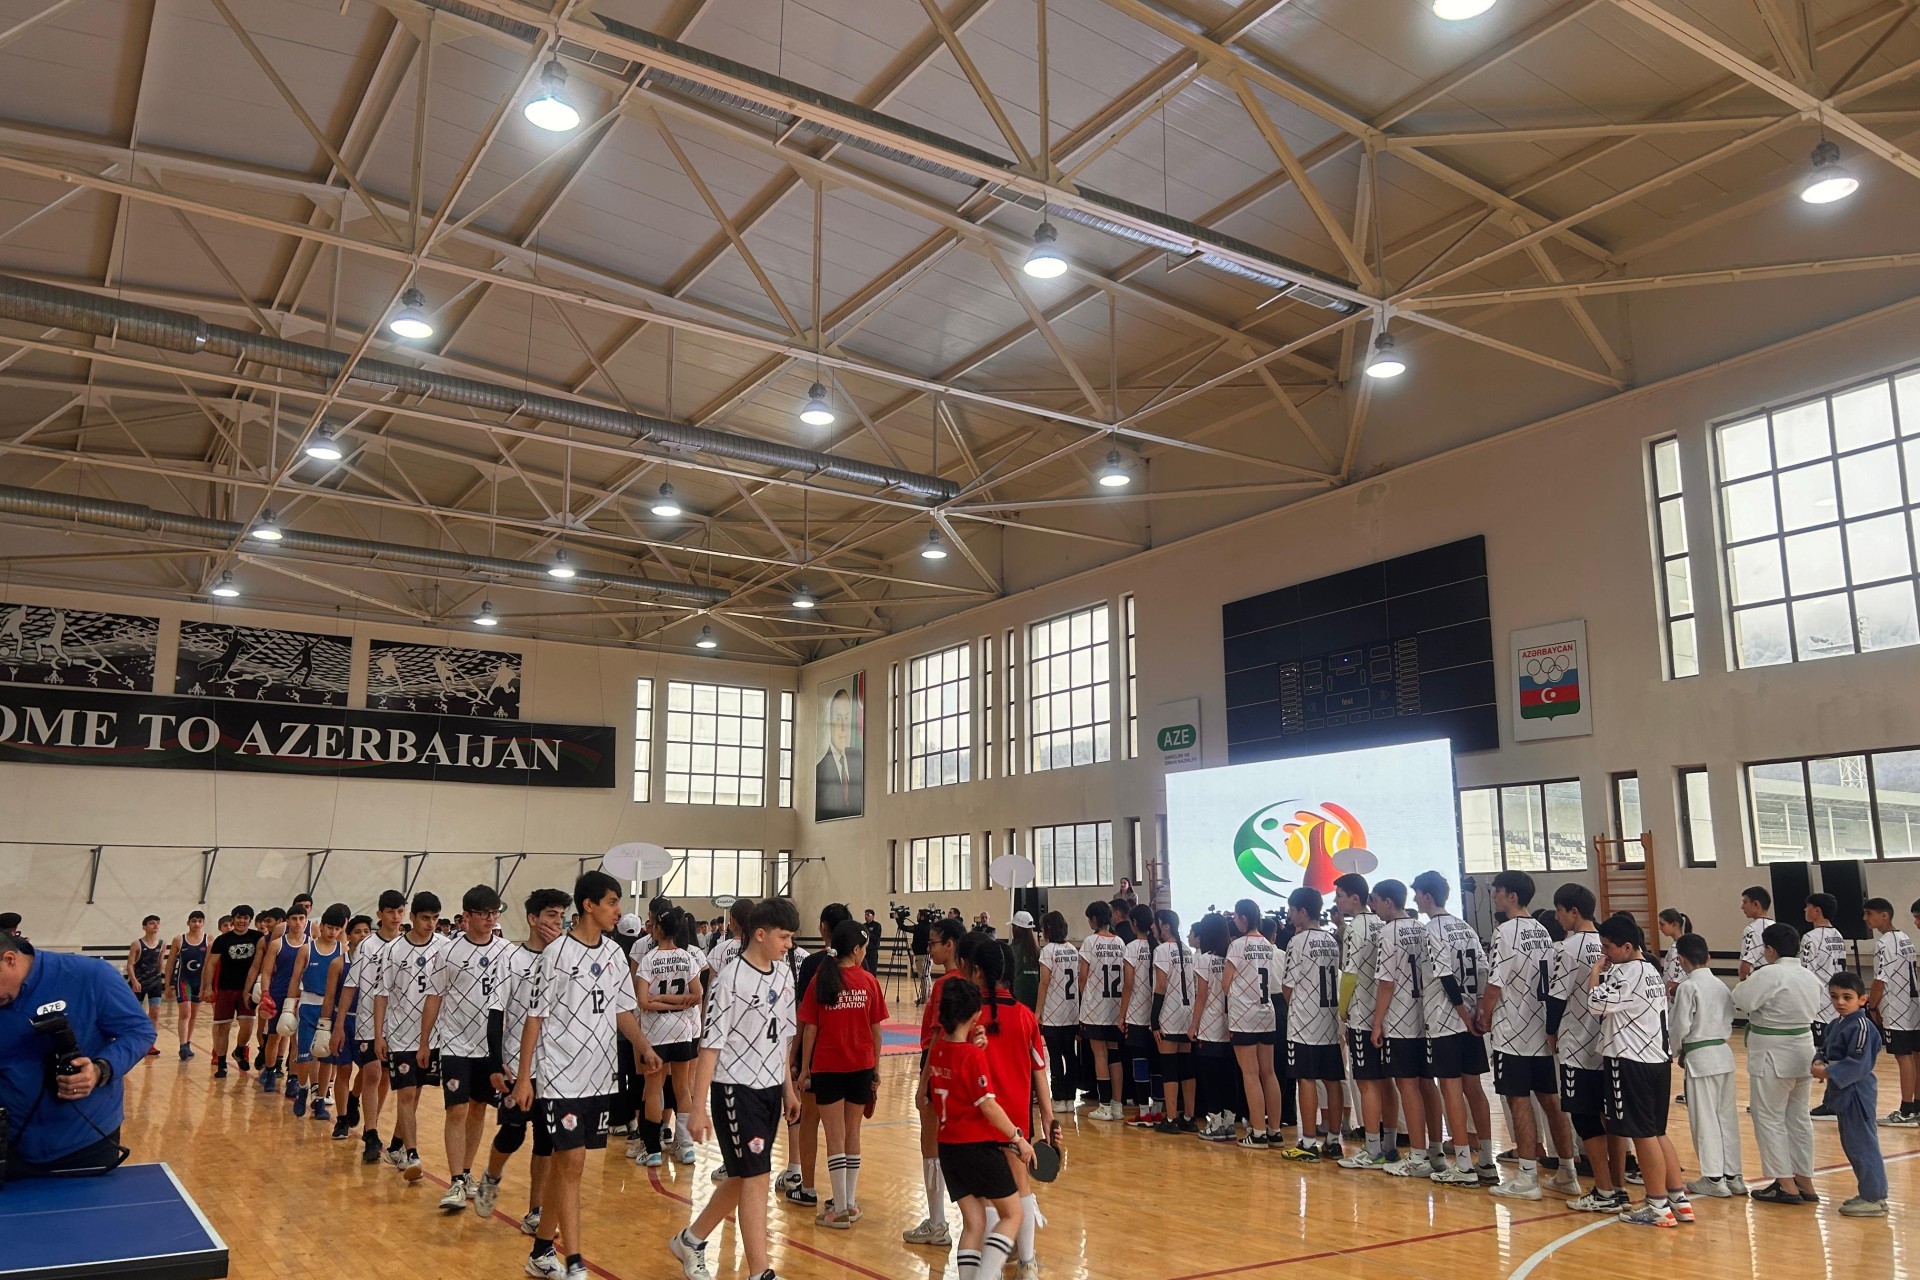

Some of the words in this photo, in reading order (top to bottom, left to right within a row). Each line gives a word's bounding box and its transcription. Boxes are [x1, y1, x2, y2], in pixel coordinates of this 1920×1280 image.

[1522, 644, 1573, 658] AZƏRBAYCAN
[138, 713, 220, 754] TO
[234, 719, 564, 772] AZERBAIJAN
[1164, 728, 1190, 747] AZE
[1102, 965, 1122, 998] 12
[1457, 948, 1478, 994] 13
[418, 976, 426, 993] 5
[482, 977, 491, 995] 6
[1064, 968, 1075, 1000] 2
[1258, 968, 1269, 1004] 3
[1319, 966, 1339, 1008] 11
[42, 1002, 62, 1014] AZE
[591, 990, 604, 1014] 12
[767, 1017, 778, 1043] 4
[430, 1061, 437, 1073] 5
[934, 1088, 949, 1123] 7
[597, 1111, 609, 1130] 12
